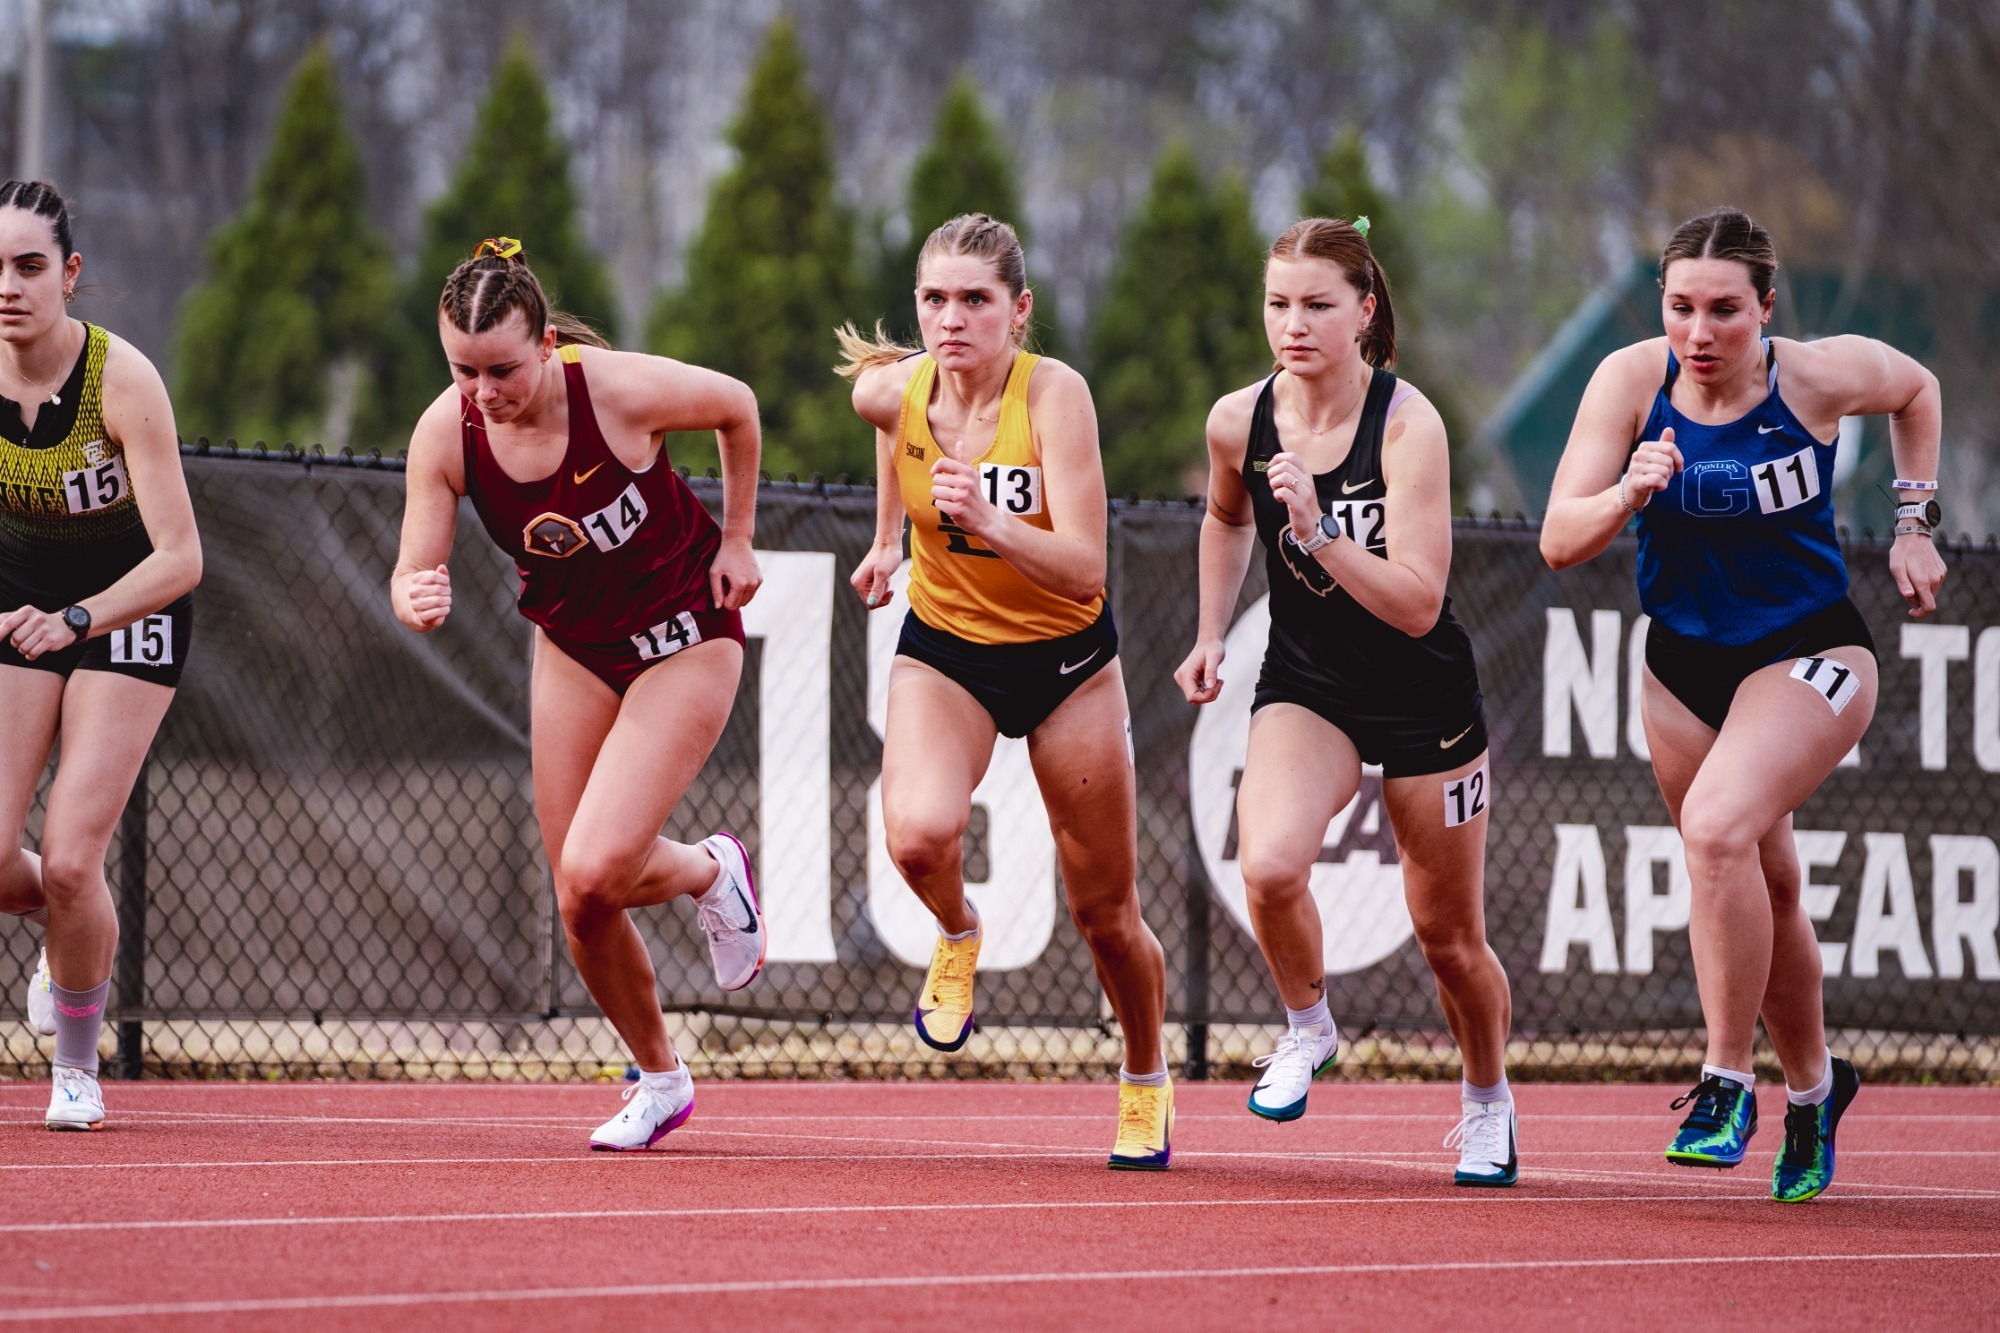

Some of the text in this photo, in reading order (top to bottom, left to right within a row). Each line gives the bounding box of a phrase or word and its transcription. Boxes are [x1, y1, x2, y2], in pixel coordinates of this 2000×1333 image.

[69, 461, 119, 510] 15
[983, 466, 1033, 514] 13
[1682, 460, 1749, 517] G
[1694, 463, 1738, 475] PIONEERS
[1758, 455, 1809, 509] 11
[591, 493, 641, 546] 14
[1337, 502, 1385, 548] 12
[123, 617, 164, 662] 15
[636, 616, 690, 656] 14
[1802, 657, 1851, 701] 11
[1449, 770, 1485, 824] 12
[1540, 823, 2000, 980] APEAR
